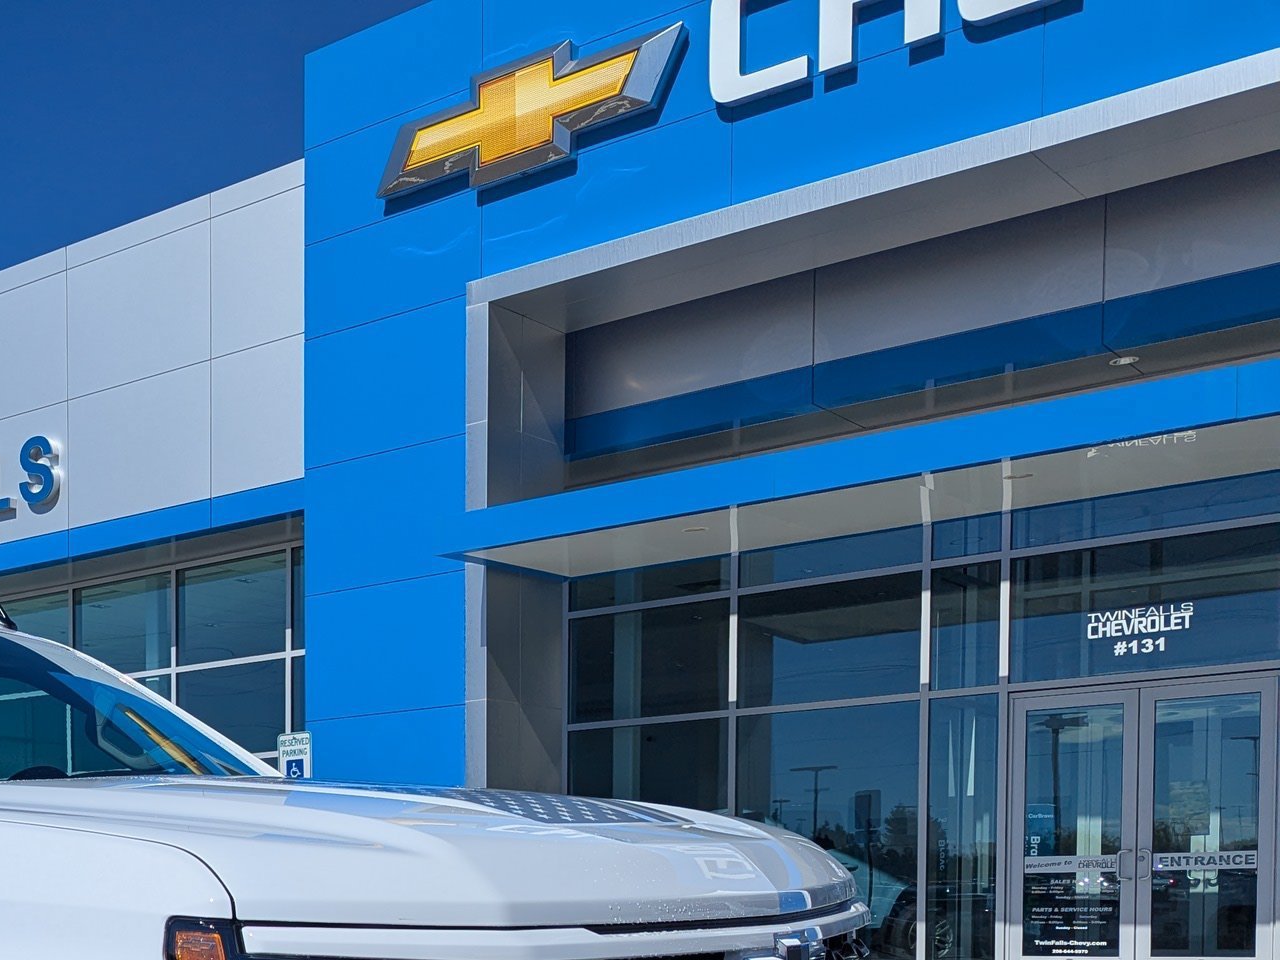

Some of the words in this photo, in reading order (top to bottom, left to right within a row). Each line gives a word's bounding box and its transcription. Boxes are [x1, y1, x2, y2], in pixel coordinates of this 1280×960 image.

[1087, 602, 1194, 623] TWINFALLS
[1087, 612, 1194, 639] CHEVROLET
[1113, 637, 1165, 656] #131
[280, 737, 310, 747] RESERVED
[282, 748, 308, 757] PARKING
[1026, 861, 1062, 869] Welcome
[1159, 854, 1256, 867] ENTRANCE
